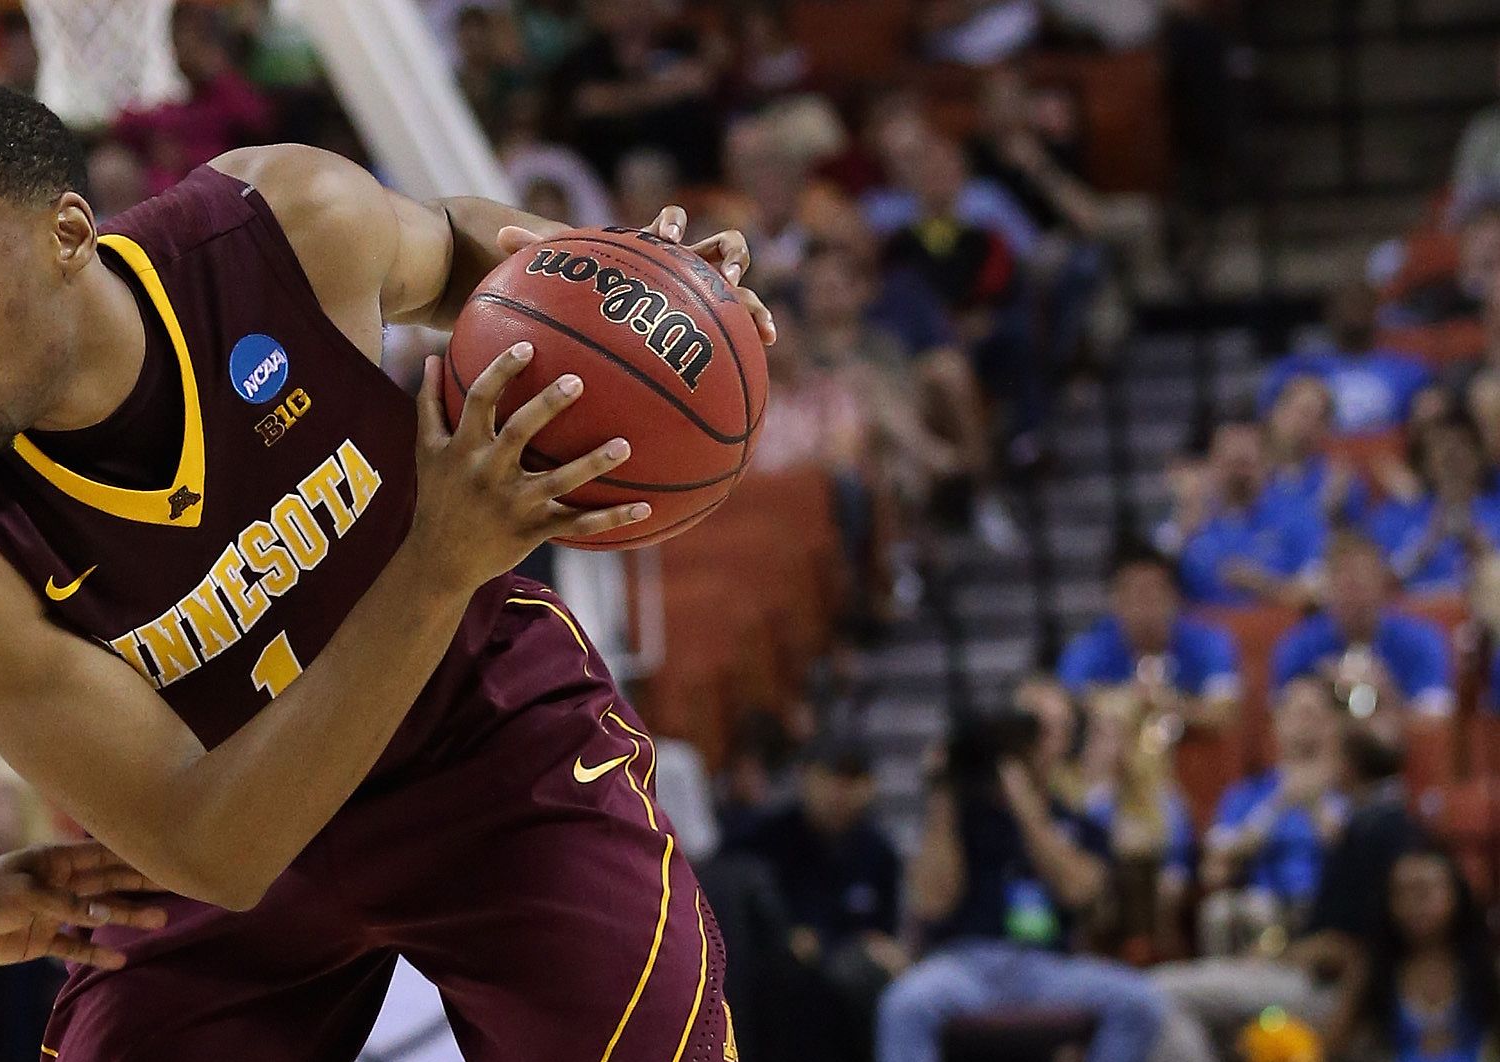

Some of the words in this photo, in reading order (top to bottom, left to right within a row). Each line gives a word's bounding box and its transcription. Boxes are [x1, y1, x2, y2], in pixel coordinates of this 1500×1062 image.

[242, 349, 287, 398] NCAA
[525, 248, 714, 394] Wilson
[96, 438, 382, 689] INNESOTA
